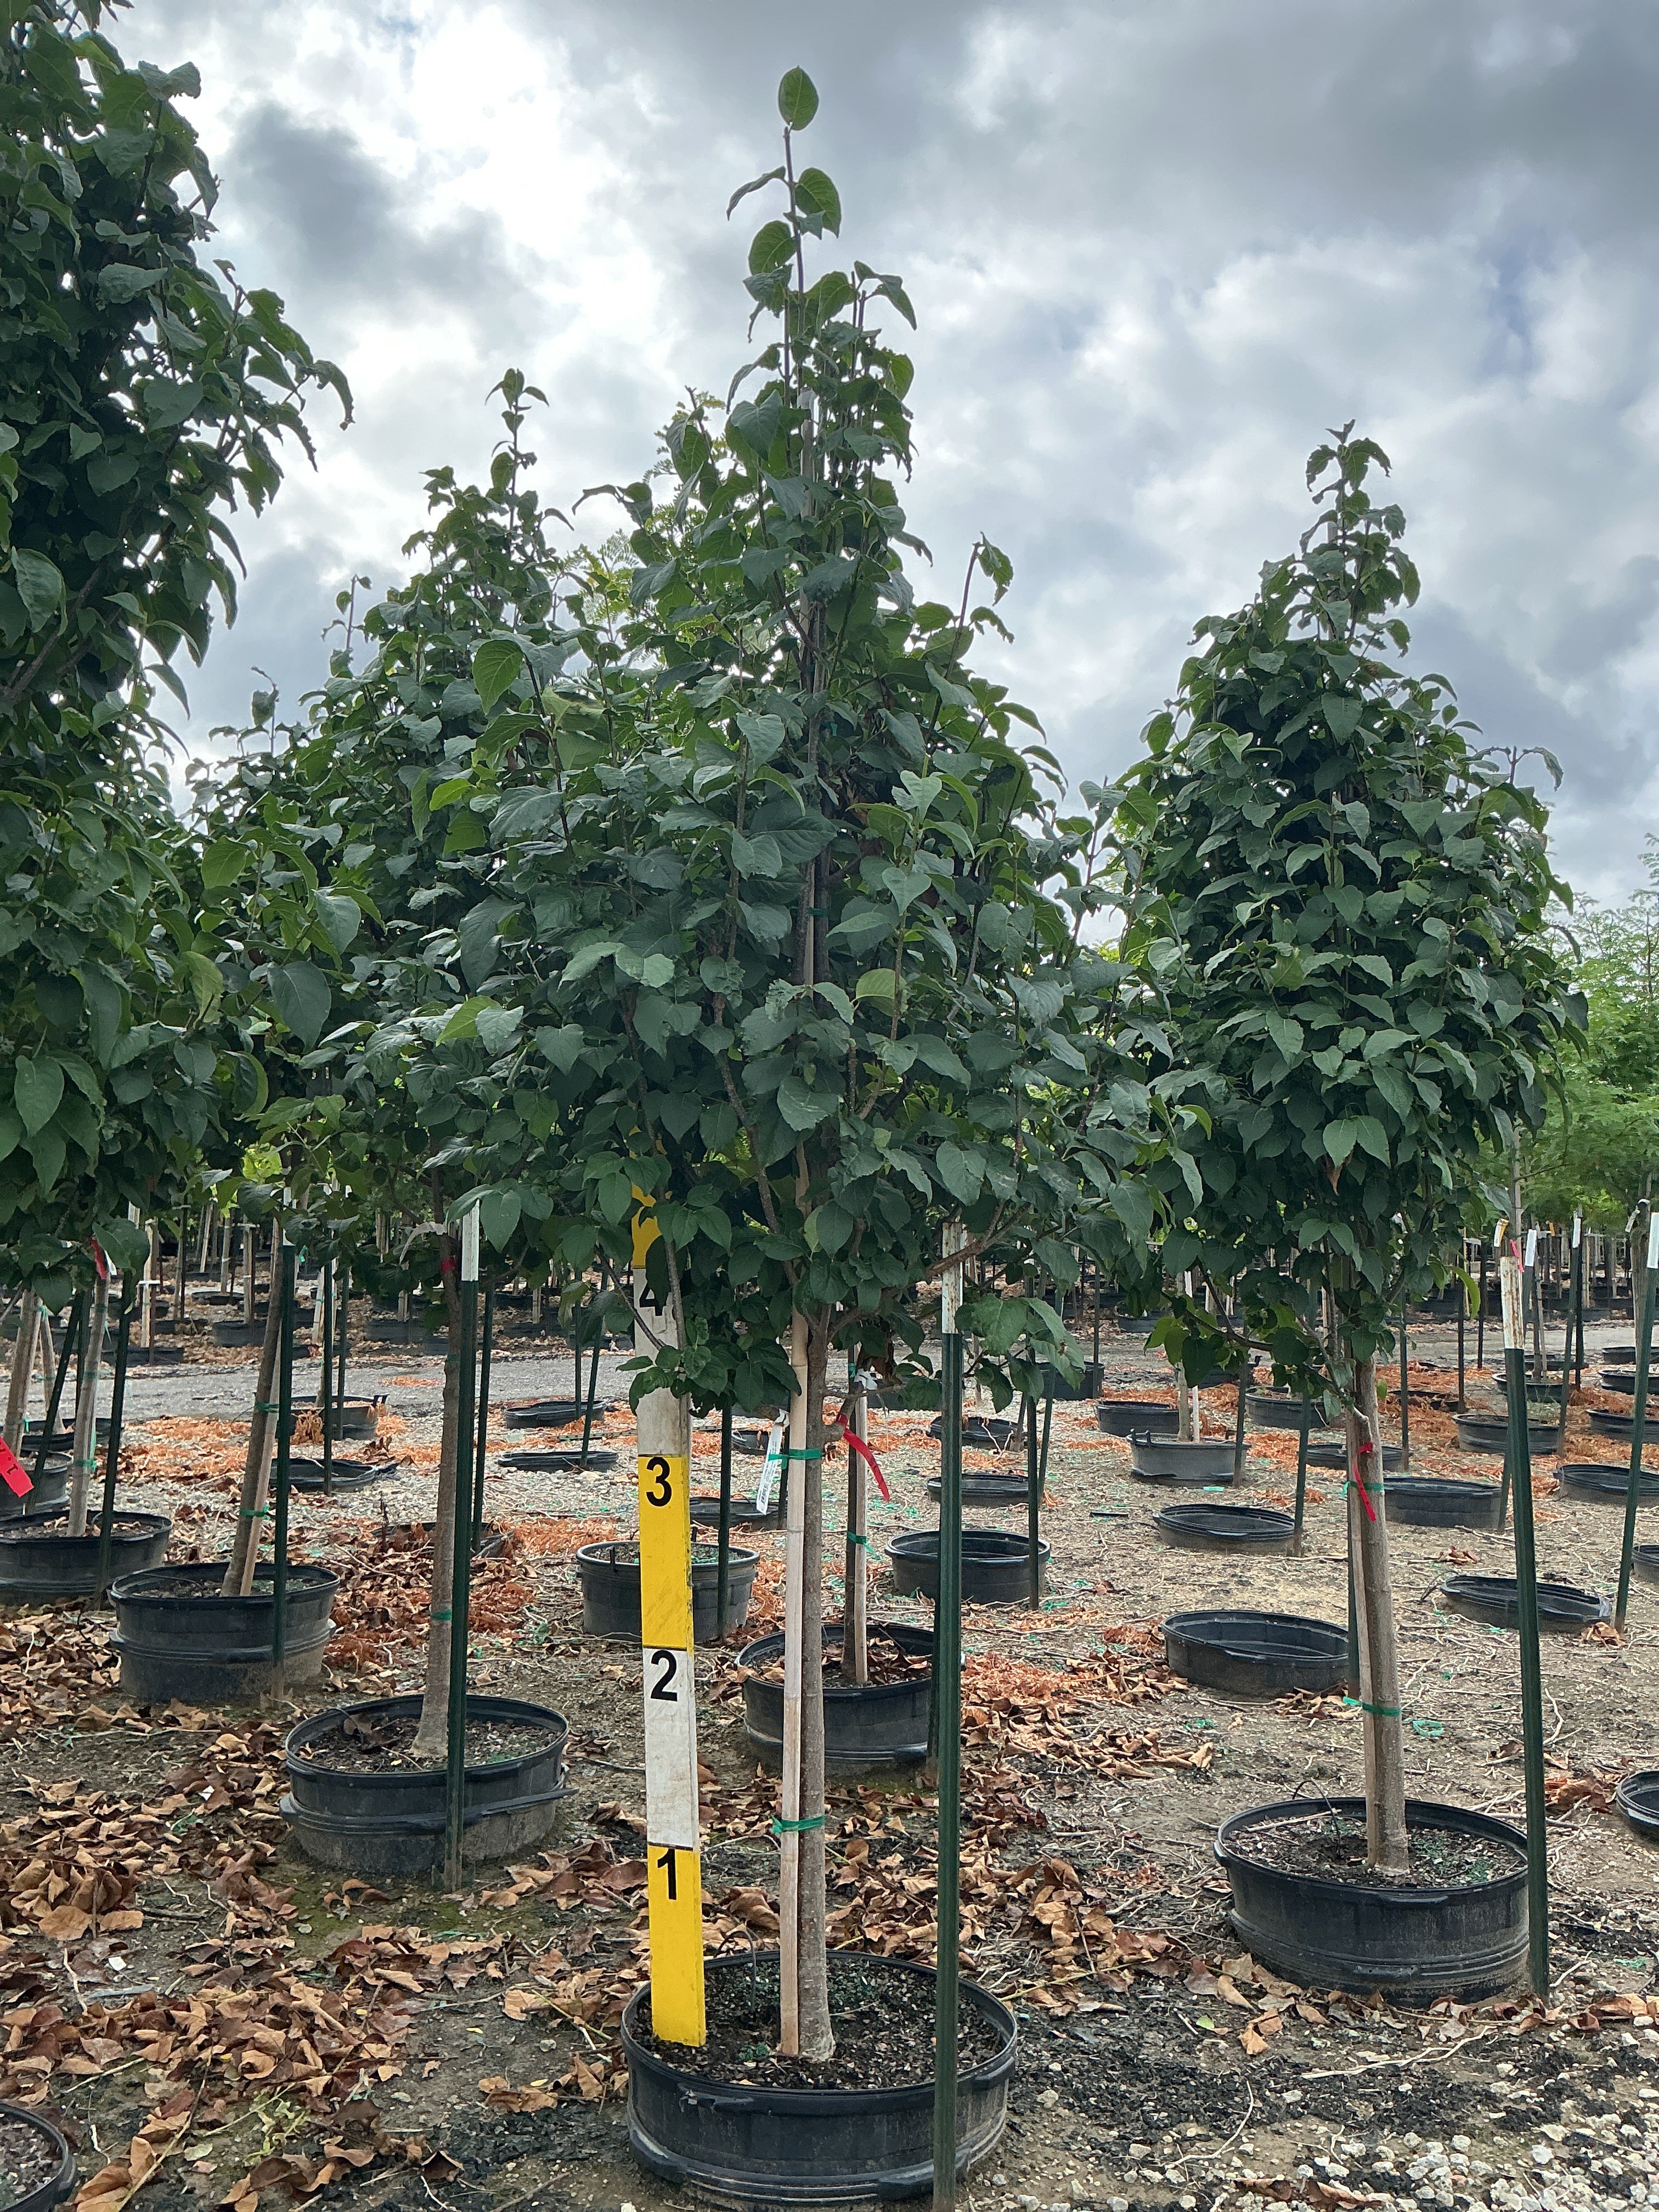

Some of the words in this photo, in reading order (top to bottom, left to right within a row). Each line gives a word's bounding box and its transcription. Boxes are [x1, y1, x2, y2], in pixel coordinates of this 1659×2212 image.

[646, 1457, 672, 1507] 3
[651, 1650, 678, 1702] 2
[657, 1848, 676, 1900] 1
